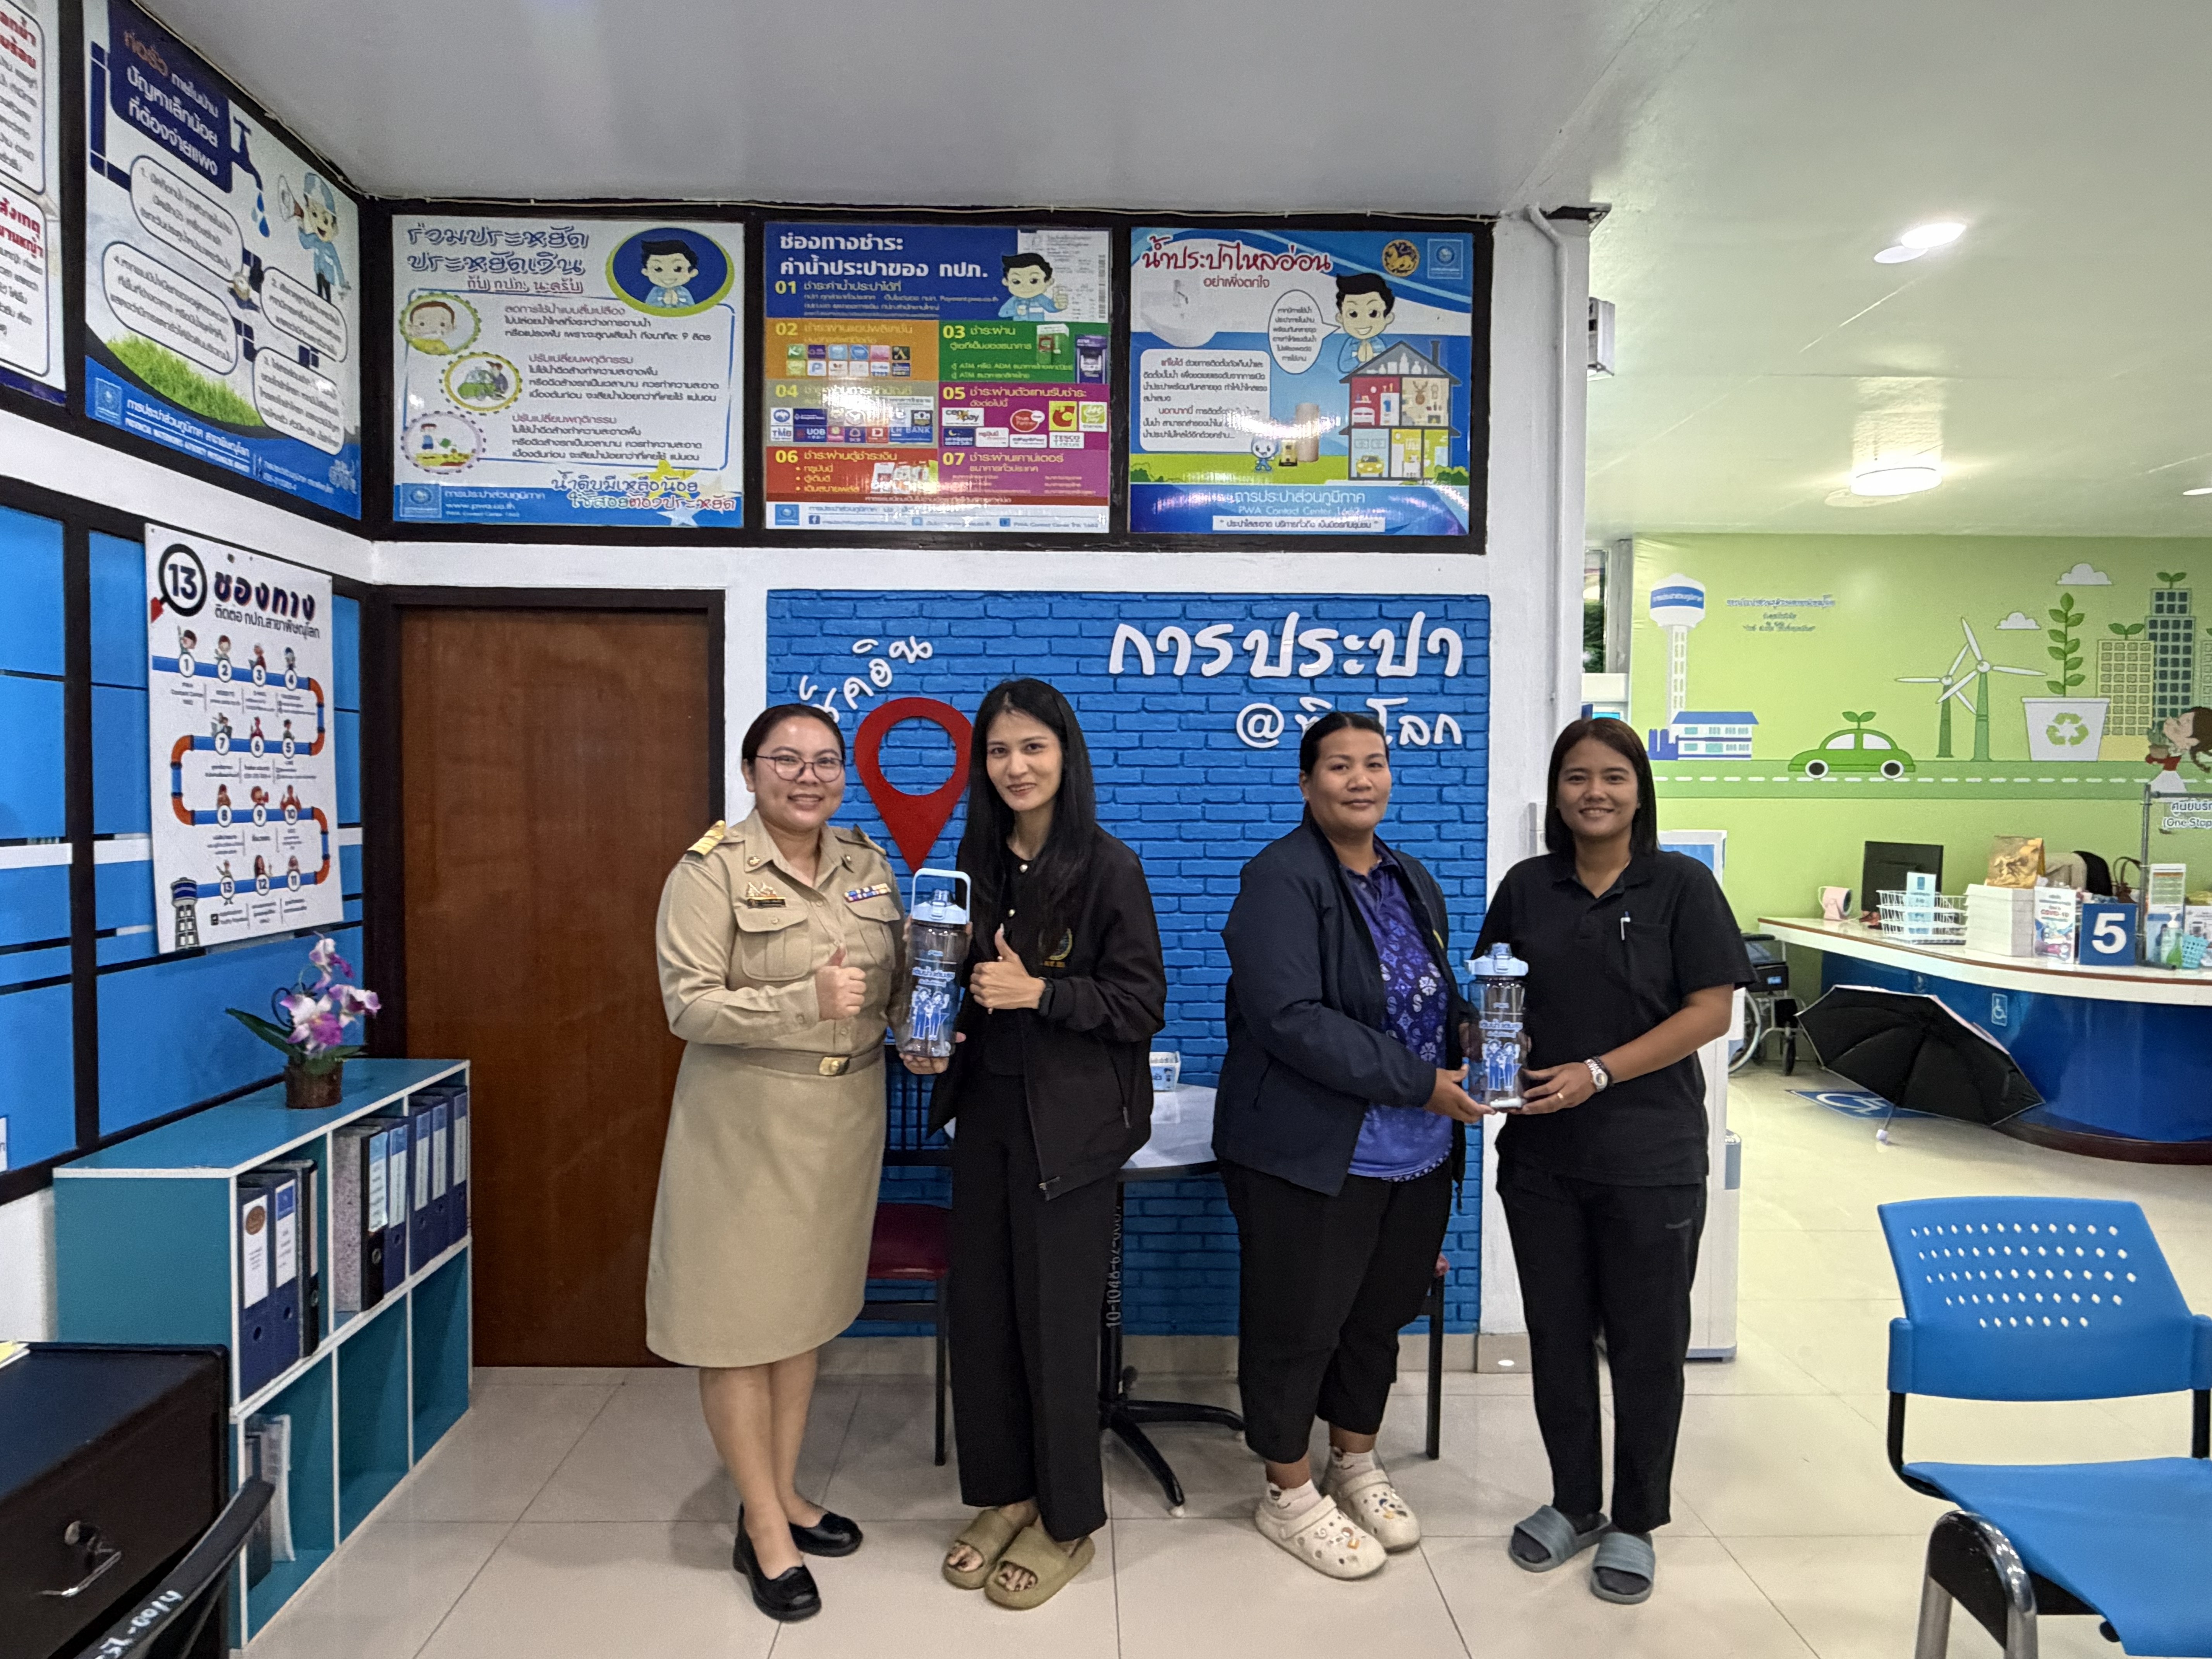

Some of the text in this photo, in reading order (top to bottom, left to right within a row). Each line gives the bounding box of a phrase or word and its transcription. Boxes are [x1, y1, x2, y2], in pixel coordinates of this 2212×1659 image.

[127, 65, 218, 148] ปัญหาเล็กน้อย
[129, 96, 218, 175] ที่ต้องจ่ายแพง
[407, 223, 589, 249] ร่วมประหยัด
[780, 233, 903, 251] ช่องทางชำระ
[408, 251, 586, 276] ประหยัดเงิน
[1142, 235, 1332, 273] น้ำประปาไหลอ่อน
[780, 254, 988, 278] ค่าน้ำประปาของ กปภ.
[775, 280, 796, 294] 01
[1203, 274, 1269, 289] อย่าเพิ่งตกใจ
[775, 323, 798, 336] 02
[943, 325, 1015, 338] 03 ชำระผ่าน
[775, 385, 798, 398] 04
[943, 387, 965, 400] 05
[775, 450, 798, 463] 06
[943, 453, 965, 465] 07
[551, 470, 698, 493] น้ำดิบมีเหลือน้อย
[568, 491, 735, 510] ใช้สอยต้องประหยัด
[1236, 489, 1365, 506] การประปาส่วนภูมิภาค
[1266, 506, 1298, 515] Contact
[168, 553, 316, 621] 13 ช่องทาง
[215, 603, 243, 623] ติดต่อ
[1109, 612, 1463, 677] การประปา
[2092, 913, 2127, 954] 5
